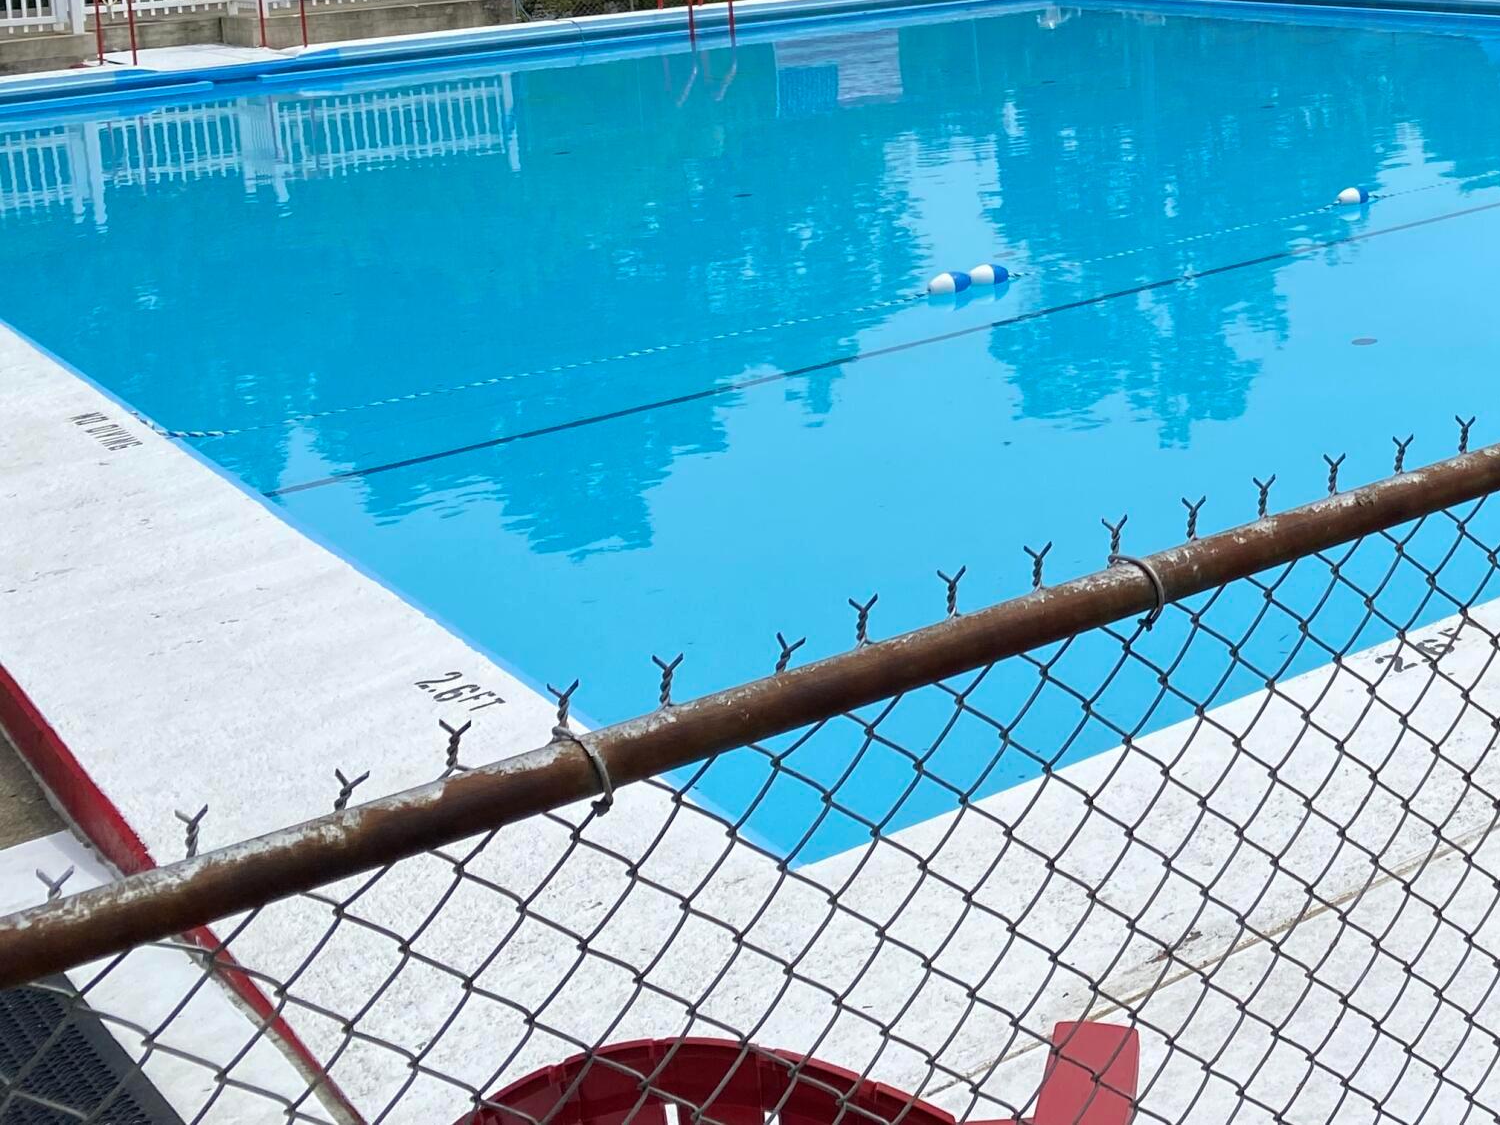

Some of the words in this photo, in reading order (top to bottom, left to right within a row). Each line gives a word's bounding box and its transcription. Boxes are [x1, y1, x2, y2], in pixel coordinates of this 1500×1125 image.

[68, 412, 109, 425] NO
[85, 424, 143, 451] DIVING
[414, 671, 506, 711] 2.6FT
